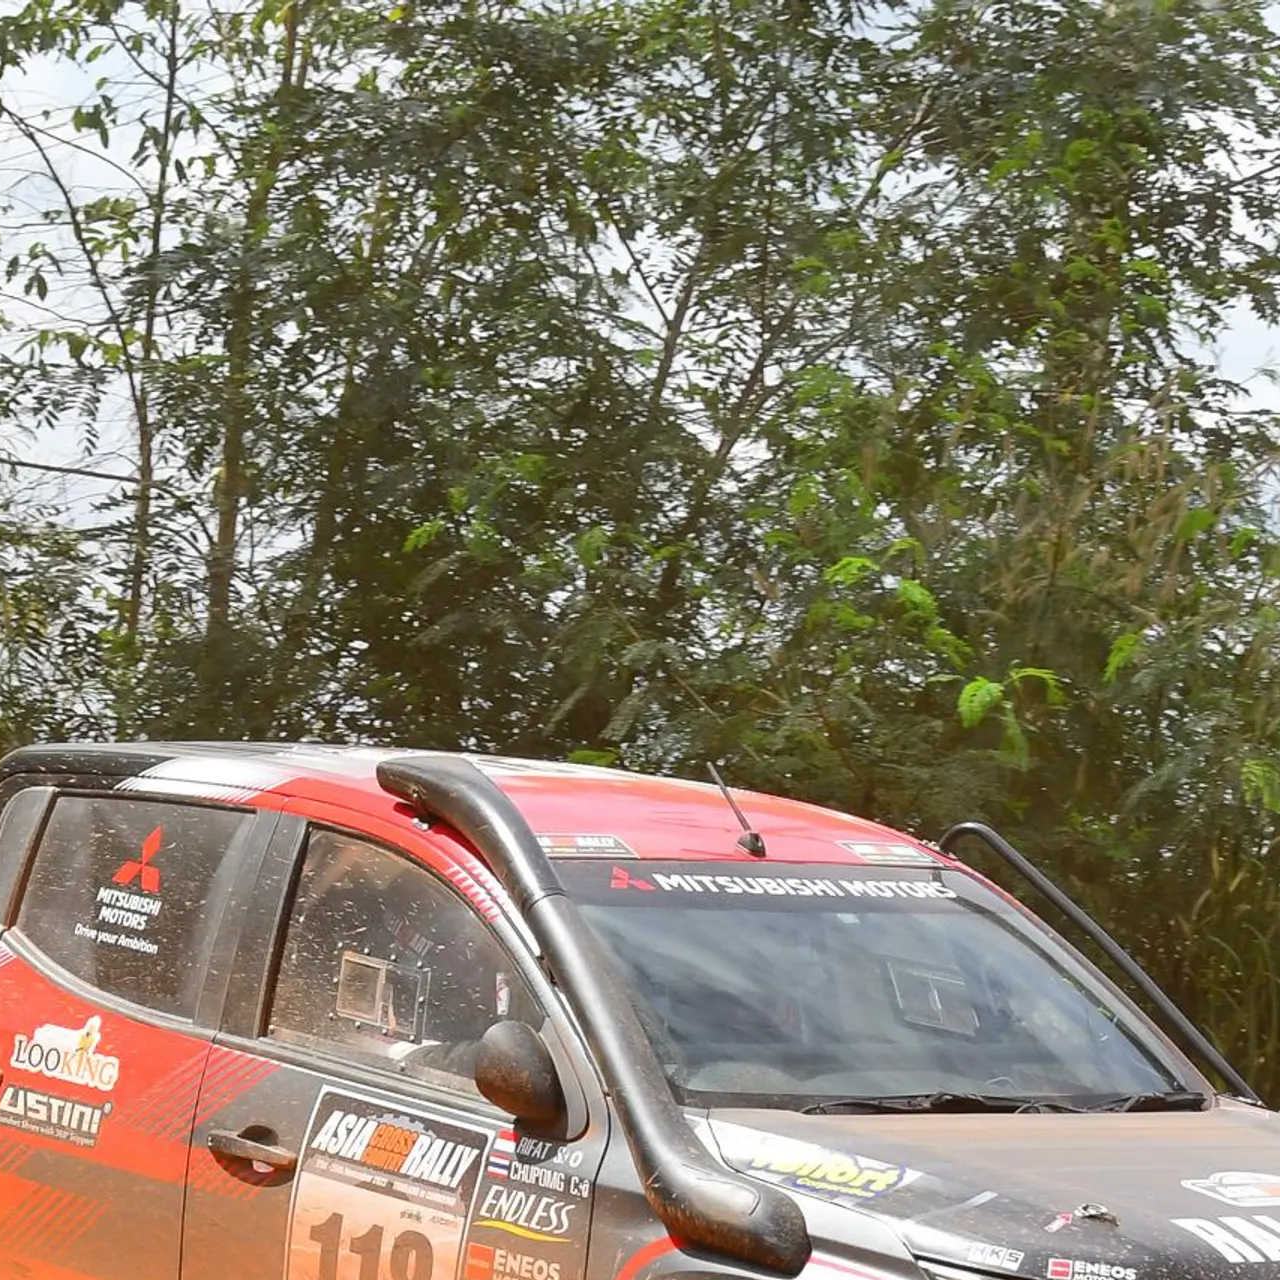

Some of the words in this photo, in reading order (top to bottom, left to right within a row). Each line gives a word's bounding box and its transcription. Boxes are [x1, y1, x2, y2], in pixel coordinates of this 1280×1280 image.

[652, 873, 845, 897] MITSUBISHI
[841, 880, 957, 899] MOTORS
[96, 887, 162, 916] MITSUBISHI
[98, 906, 148, 930] MOTORS
[74, 922, 98, 939] Drive
[97, 931, 119, 944] your
[117, 934, 158, 954] Ambition
[311, 1110, 378, 1161] ASIA
[399, 1133, 481, 1188] RALLY
[479, 1184, 576, 1234] ENDLESS
[1073, 1260, 1137, 1280] ENEOS
